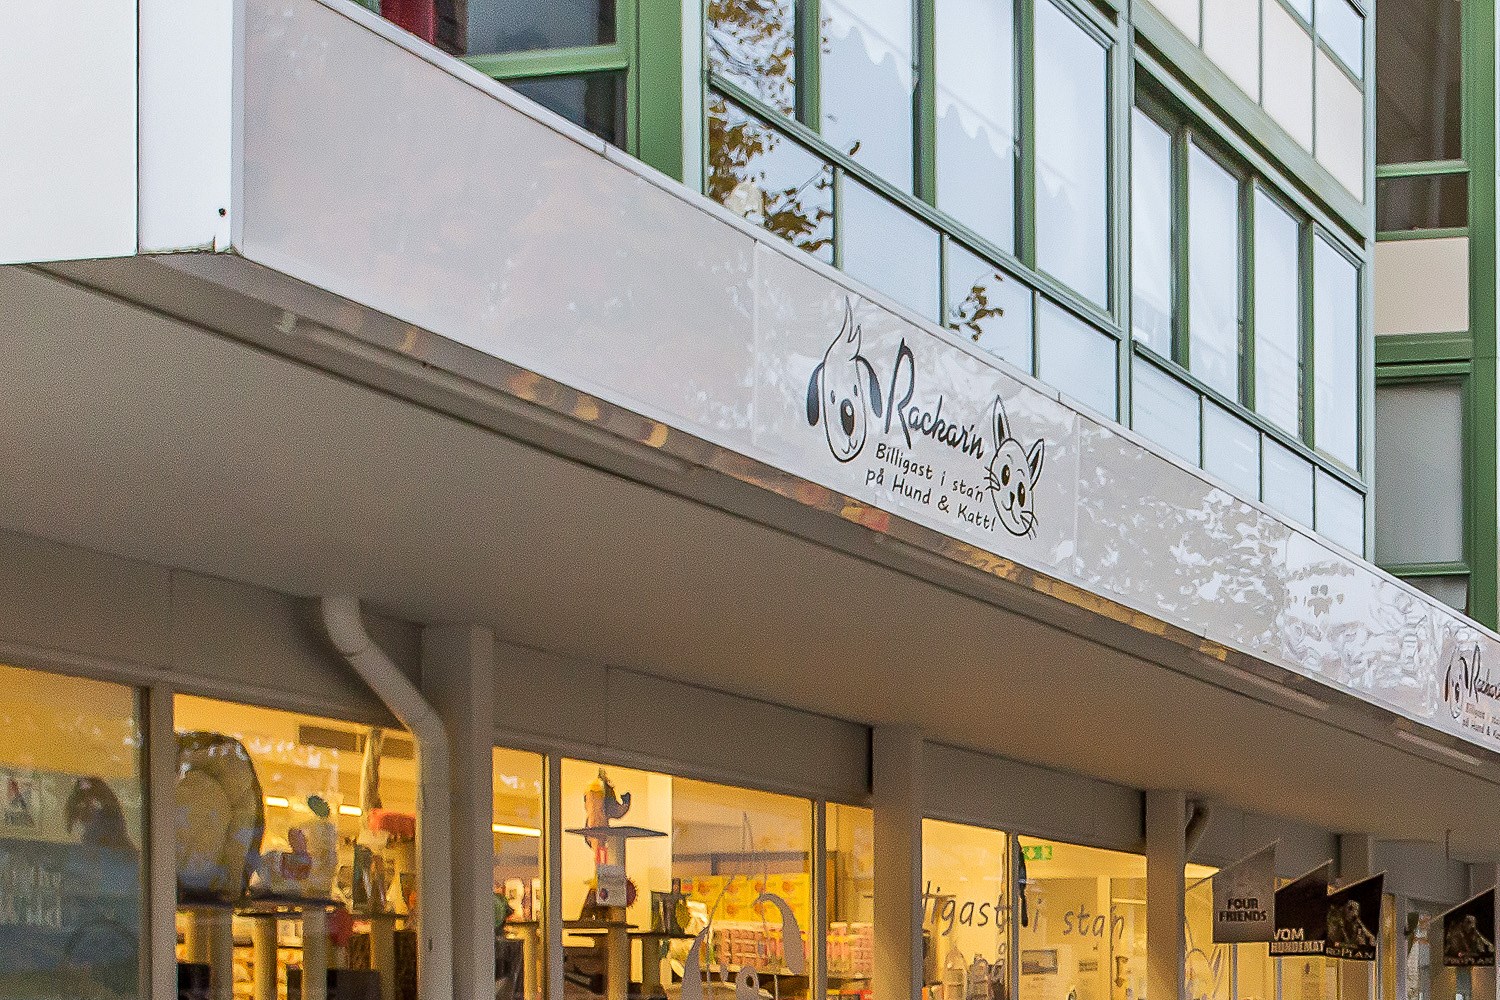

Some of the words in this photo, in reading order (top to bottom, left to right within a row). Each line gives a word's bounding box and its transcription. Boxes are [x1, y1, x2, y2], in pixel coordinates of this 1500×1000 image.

[876, 443, 933, 479] Billigast
[940, 471, 947, 486] i
[865, 467, 884, 486] på
[892, 474, 932, 505] Hund
[937, 495, 950, 513] &
[957, 503, 997, 532] Katt!
[1227, 898, 1259, 909] FOUR
[1218, 910, 1267, 923] FRIENDS
[1273, 927, 1305, 941] VOM
